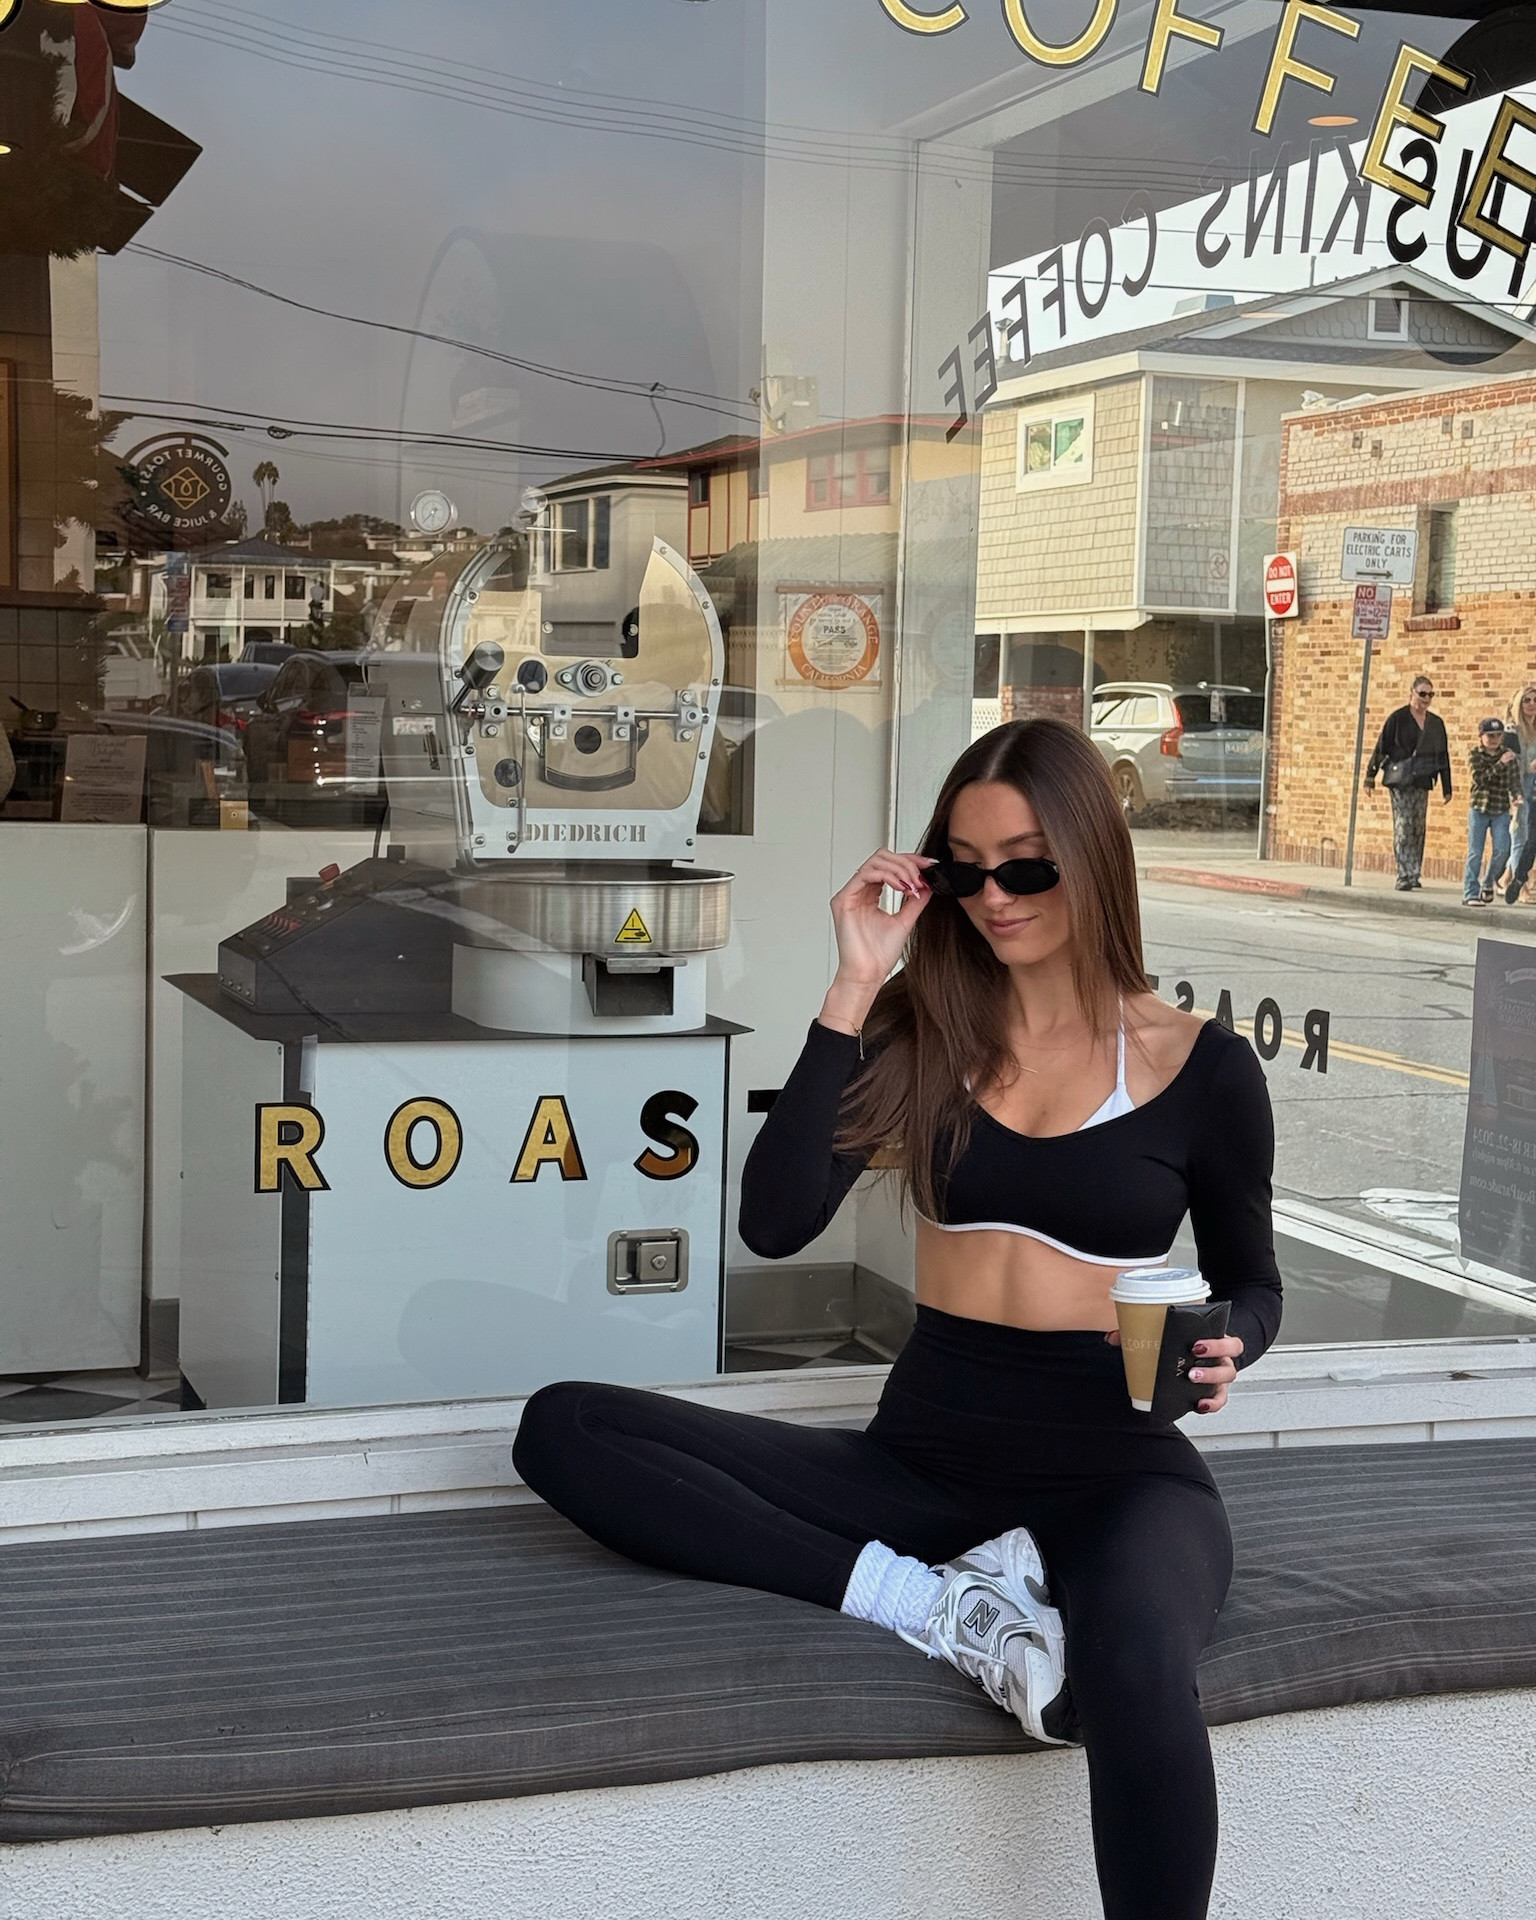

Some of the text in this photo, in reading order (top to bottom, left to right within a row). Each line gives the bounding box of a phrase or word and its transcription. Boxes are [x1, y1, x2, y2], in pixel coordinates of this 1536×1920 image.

[883, 0, 1536, 262] FFEE
[1352, 531, 1407, 545] PARKING FOR
[1346, 544, 1412, 558] ELECTRIC CARTS
[1365, 557, 1388, 569] ONLY
[1268, 564, 1291, 579] DO NOT
[1270, 592, 1292, 606] ENTER
[1357, 587, 1374, 598] NO
[1356, 599, 1389, 608] PARKING
[823, 625, 846, 635] PASS
[524, 824, 646, 842] DIEDRICH
[963, 1599, 1000, 1637] N
